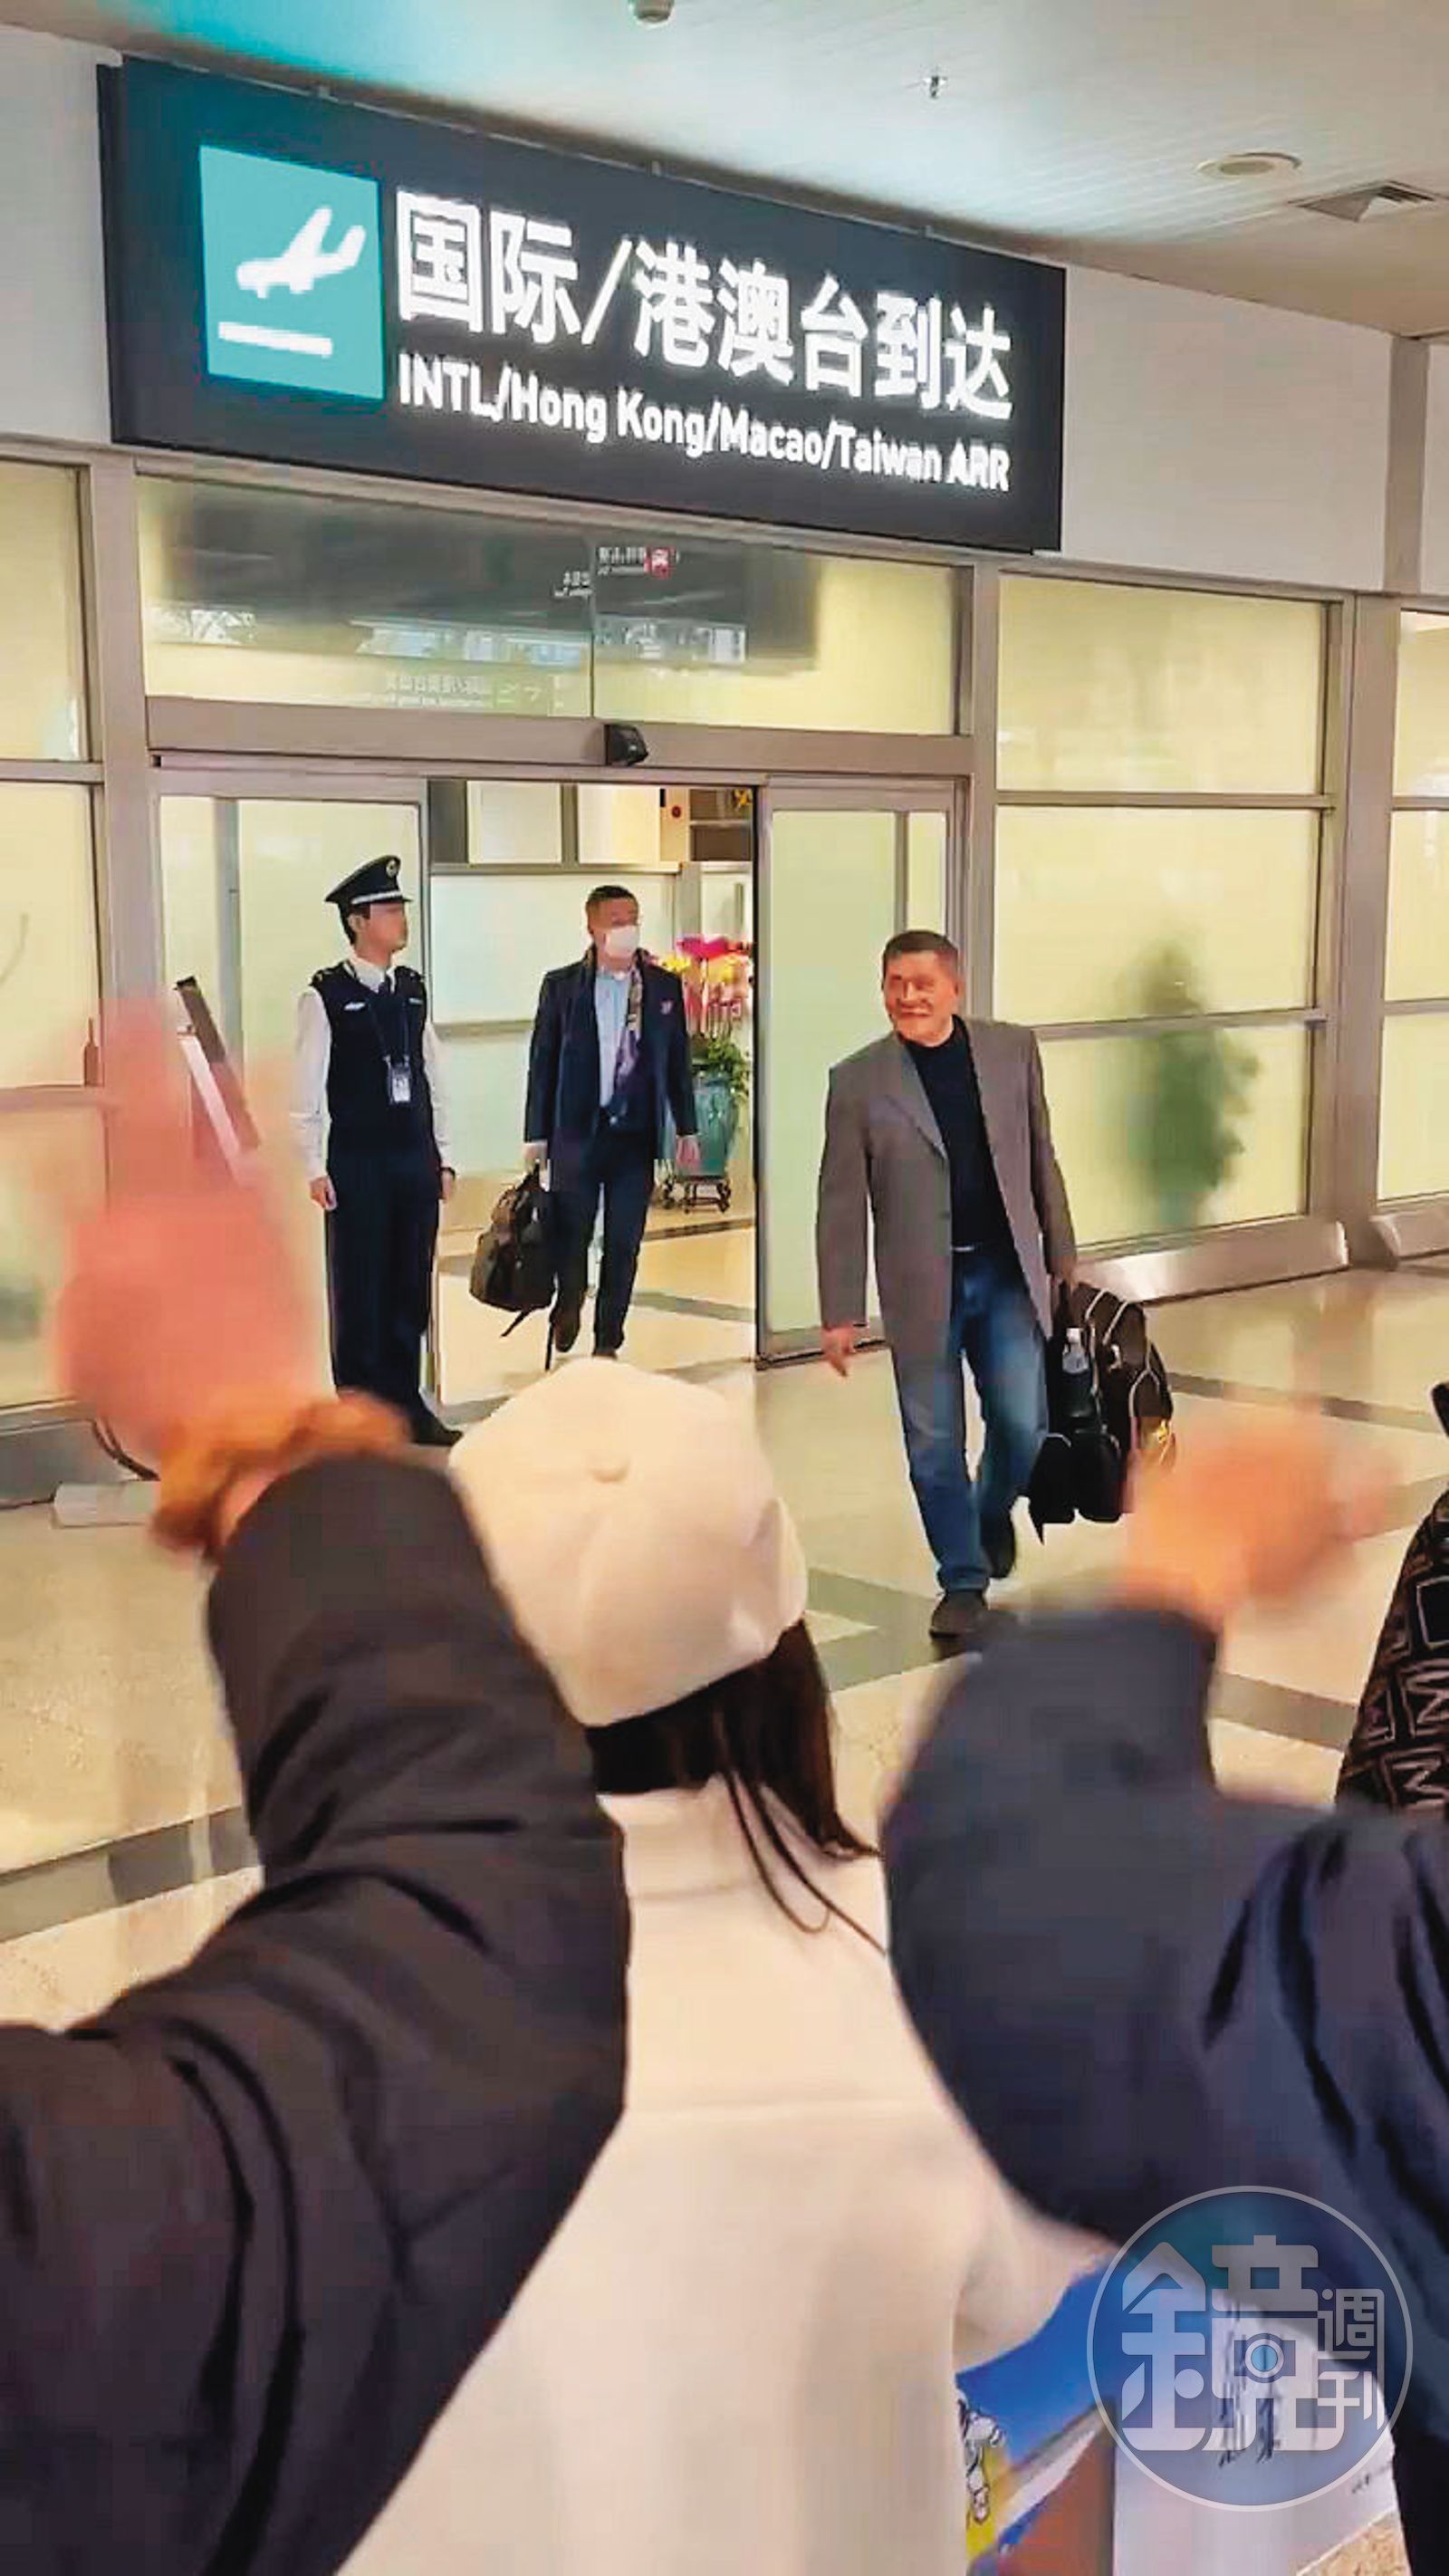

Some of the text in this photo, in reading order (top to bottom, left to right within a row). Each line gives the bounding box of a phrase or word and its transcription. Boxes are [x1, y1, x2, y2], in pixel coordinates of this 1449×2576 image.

[396, 188, 1013, 419] 国际/港澳台到达
[398, 353, 1012, 492] INTL/Hong Kong/Macao/Taiwan ARR
